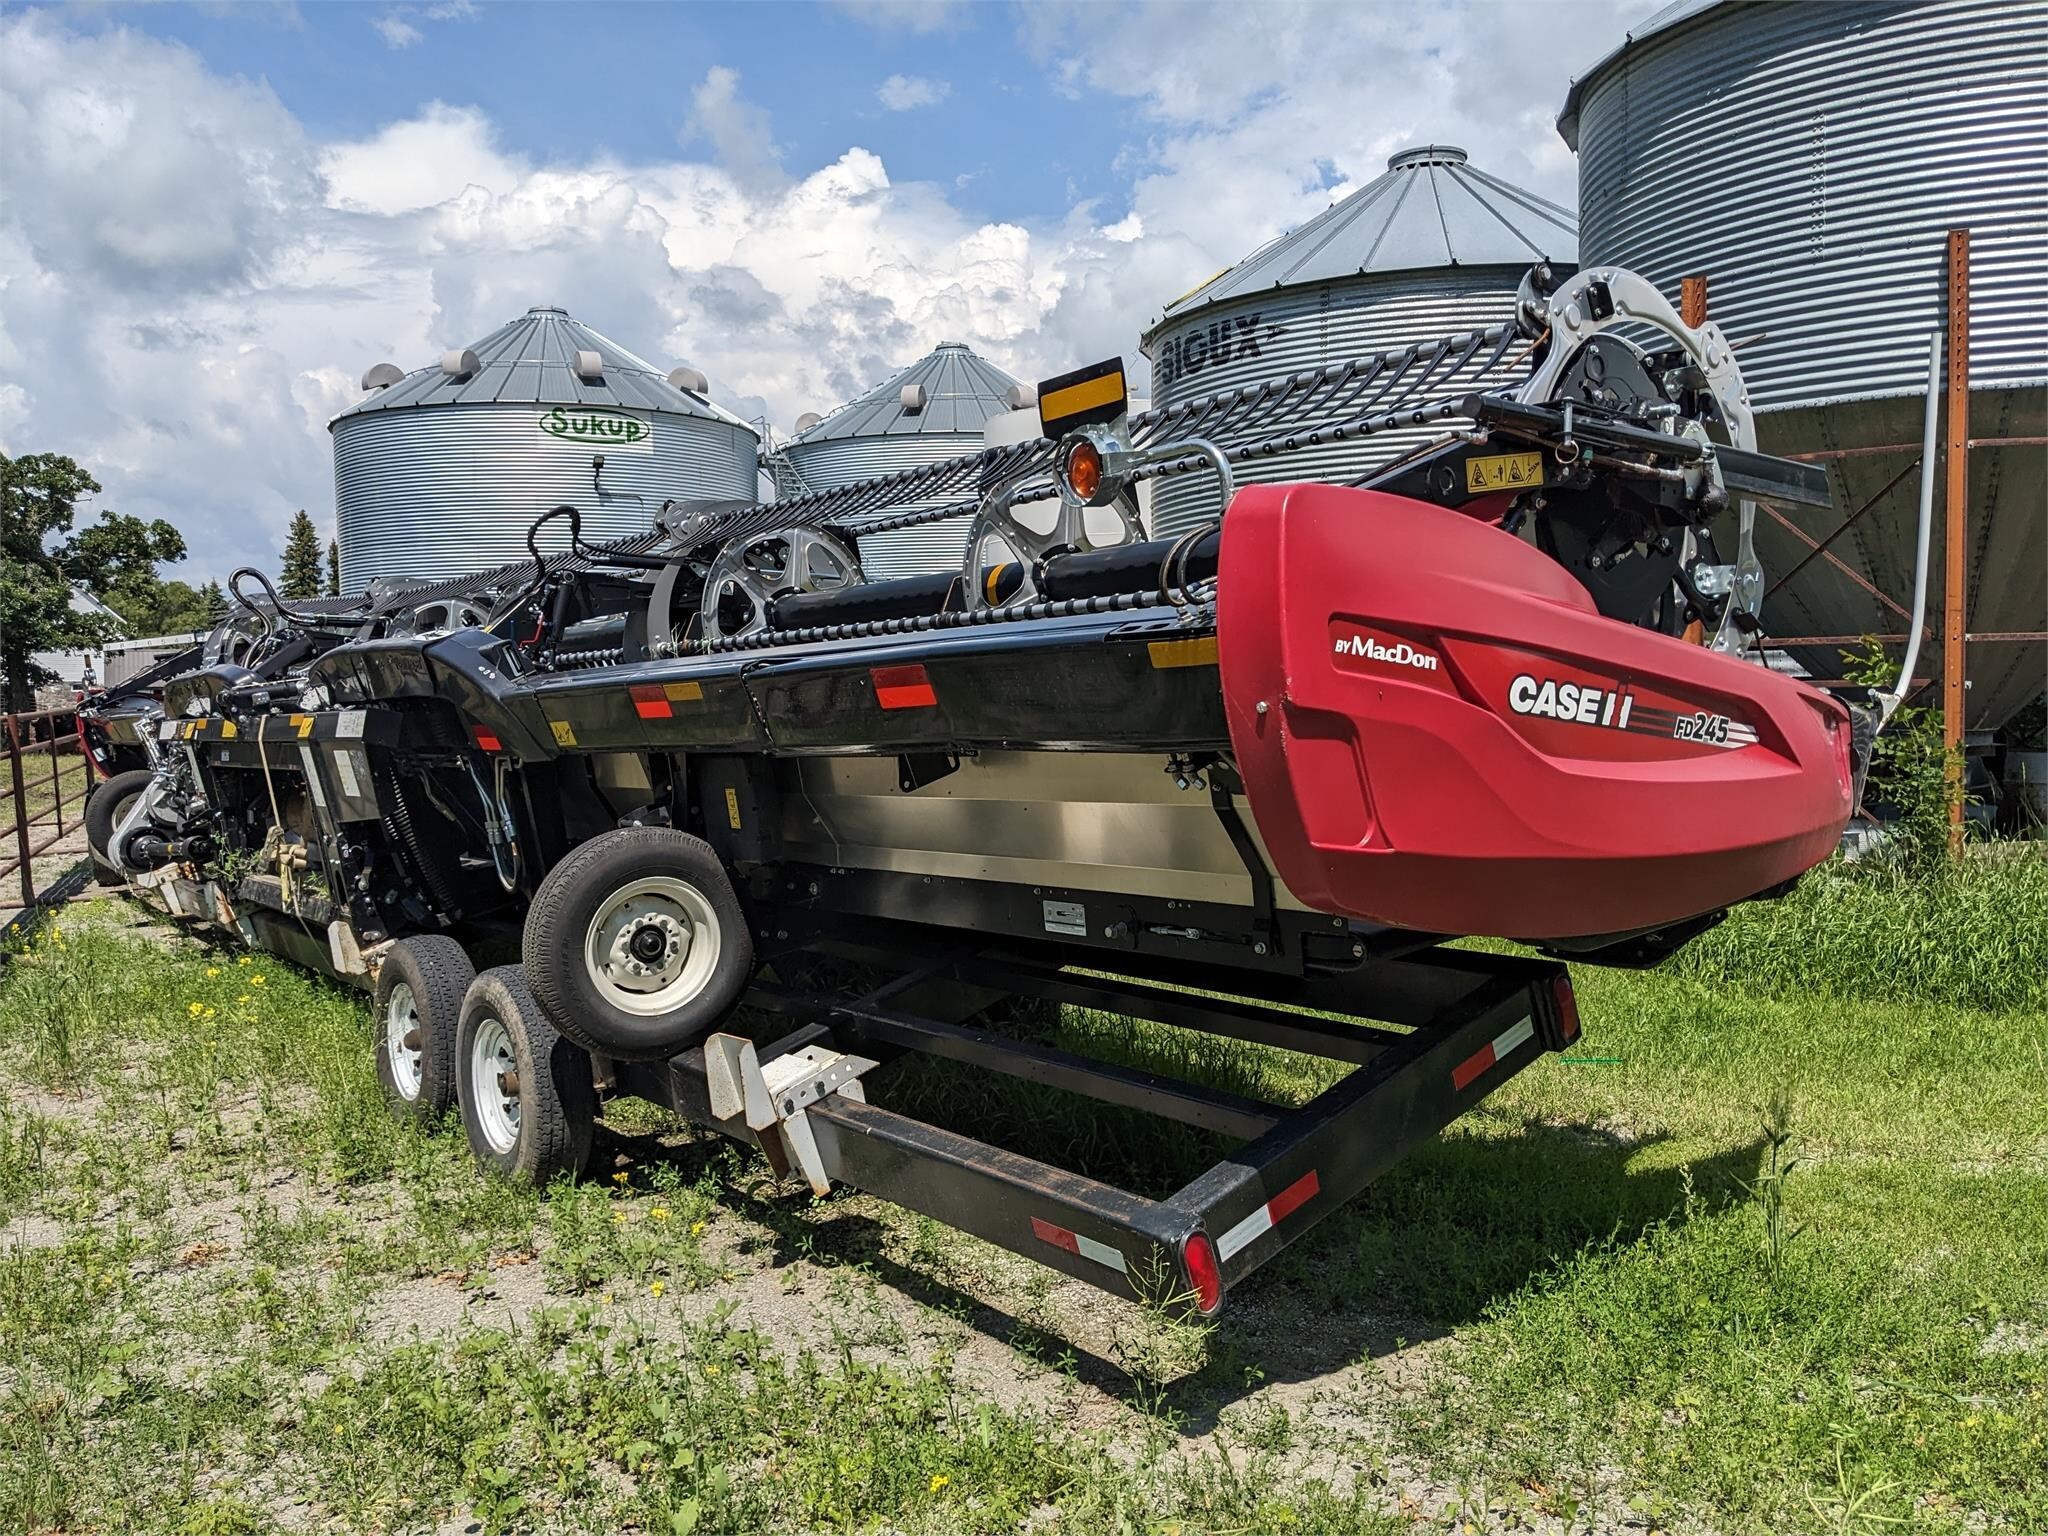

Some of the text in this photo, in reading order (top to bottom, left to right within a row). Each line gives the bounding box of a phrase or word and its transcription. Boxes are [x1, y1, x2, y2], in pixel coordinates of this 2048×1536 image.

[550, 407, 640, 442] Sukup
[1335, 635, 1437, 670] BY MacDon
[1509, 675, 1601, 724] CASE
[1674, 712, 1730, 744] FD245
